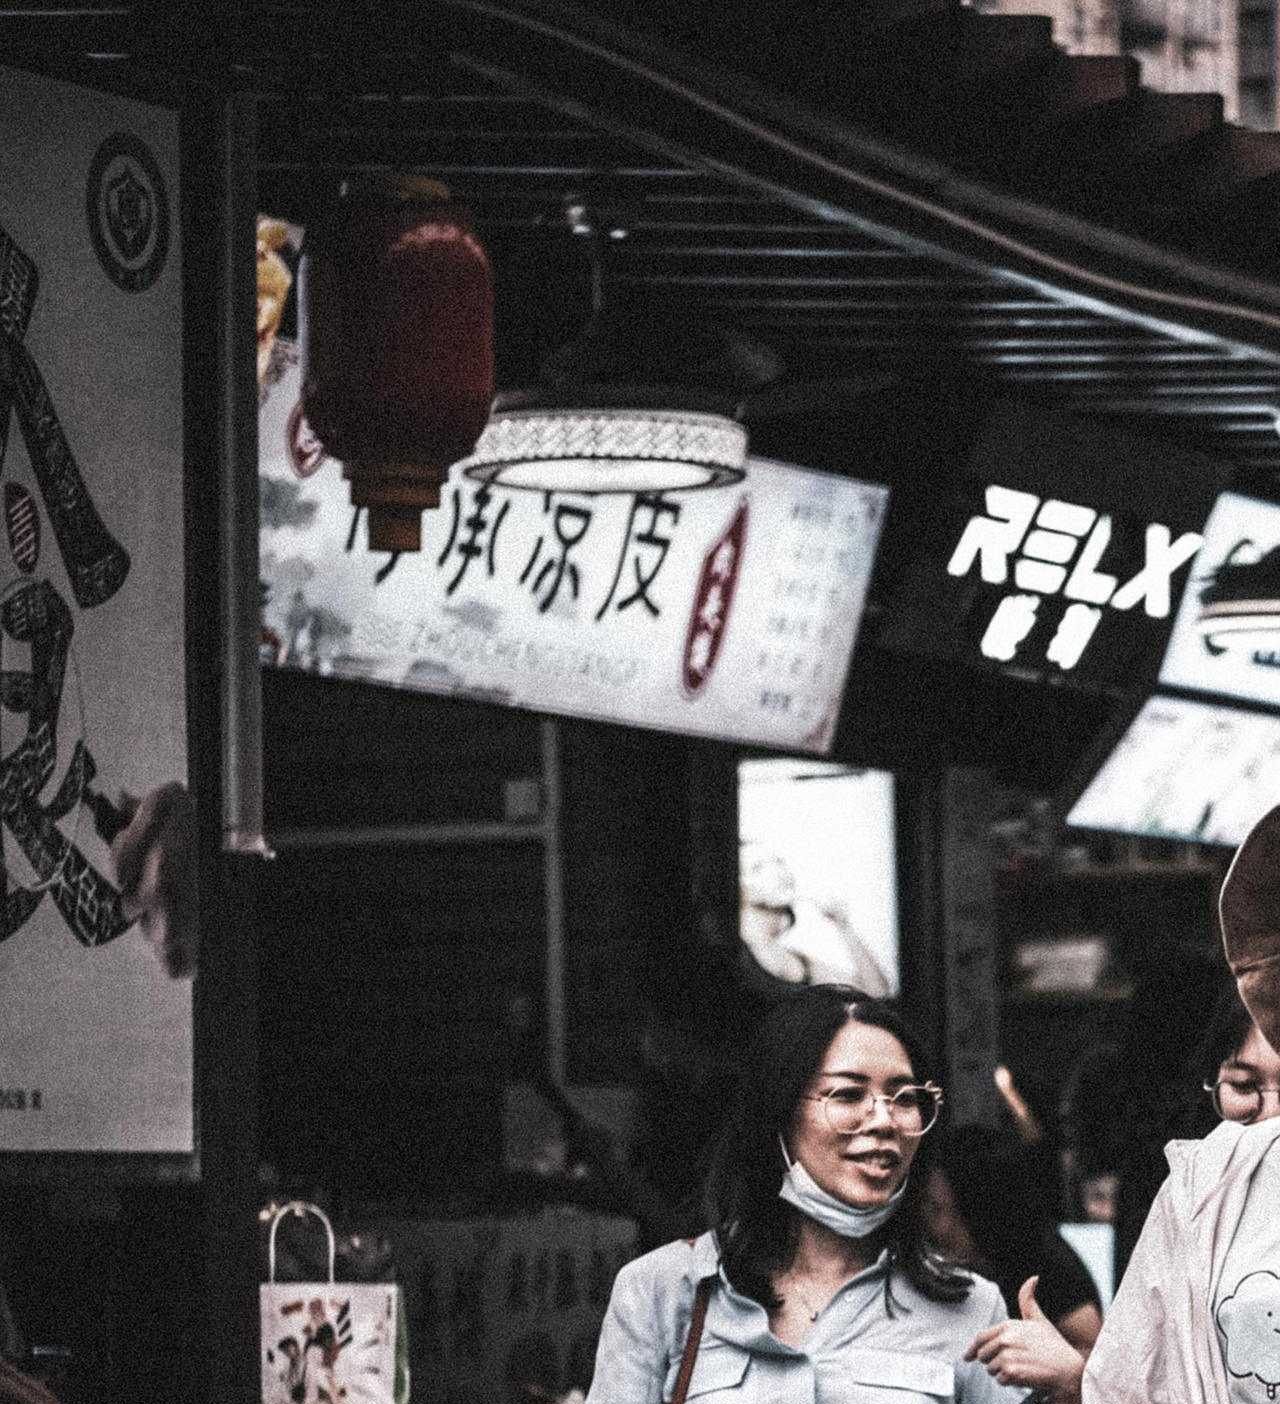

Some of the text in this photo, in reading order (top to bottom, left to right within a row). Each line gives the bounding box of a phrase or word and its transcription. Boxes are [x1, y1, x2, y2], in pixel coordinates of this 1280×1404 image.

[346, 484, 682, 622] 承凉皮
[947, 484, 1204, 619] RELX
